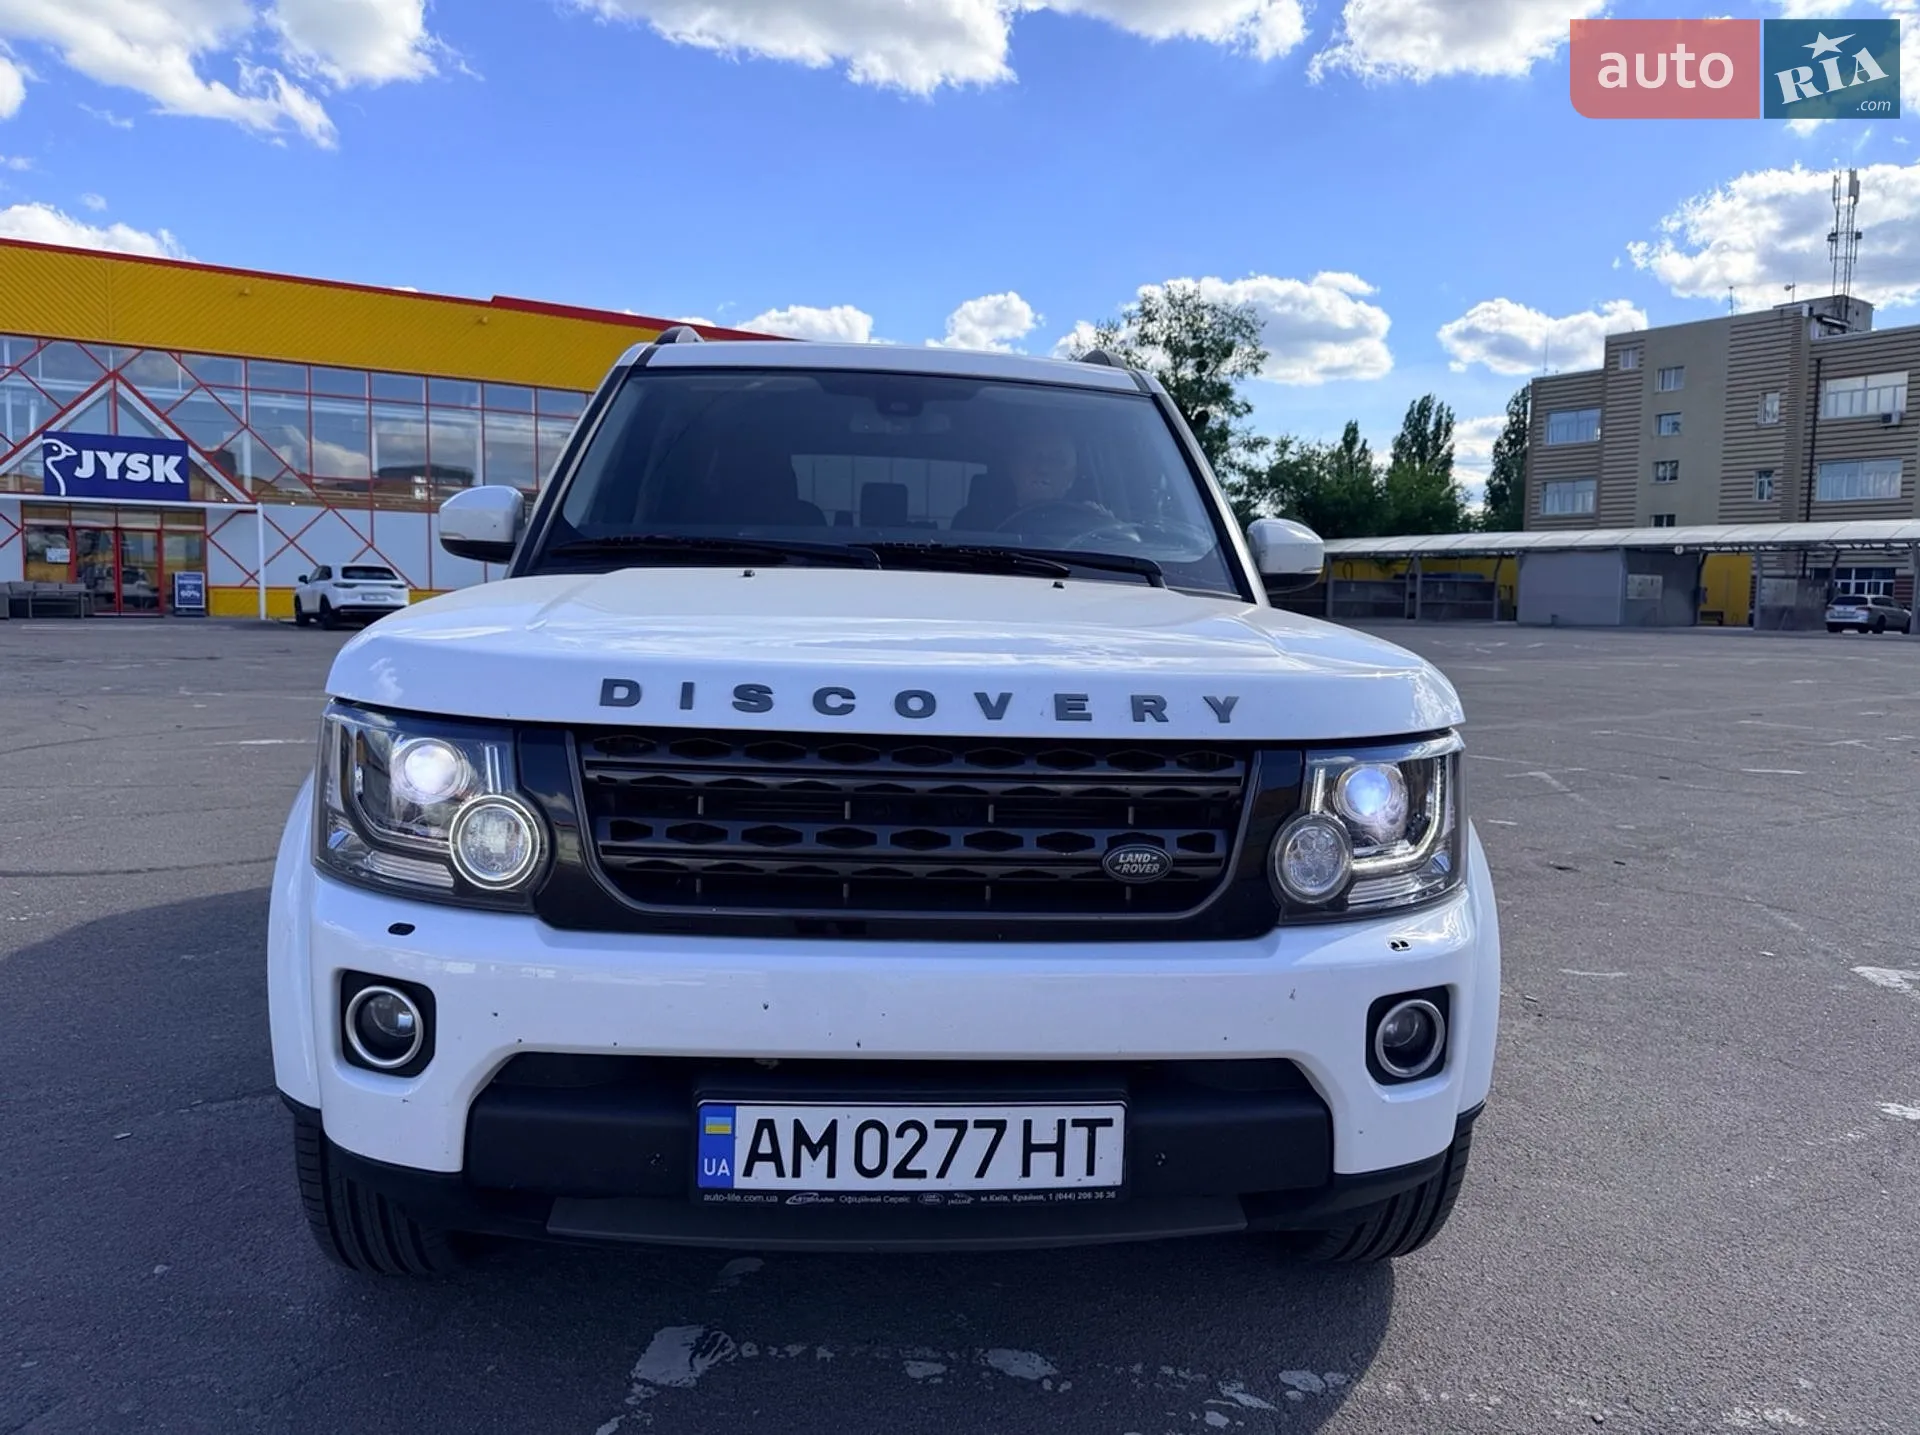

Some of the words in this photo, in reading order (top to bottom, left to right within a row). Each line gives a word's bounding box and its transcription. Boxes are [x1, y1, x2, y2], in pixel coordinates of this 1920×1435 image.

[74, 449, 184, 484] JYSK
[599, 678, 1240, 724] DISCOVERY
[703, 1158, 730, 1177] UA
[742, 1118, 838, 1179] AM
[853, 1118, 1008, 1179] 0277
[1021, 1118, 1114, 1178] HT
